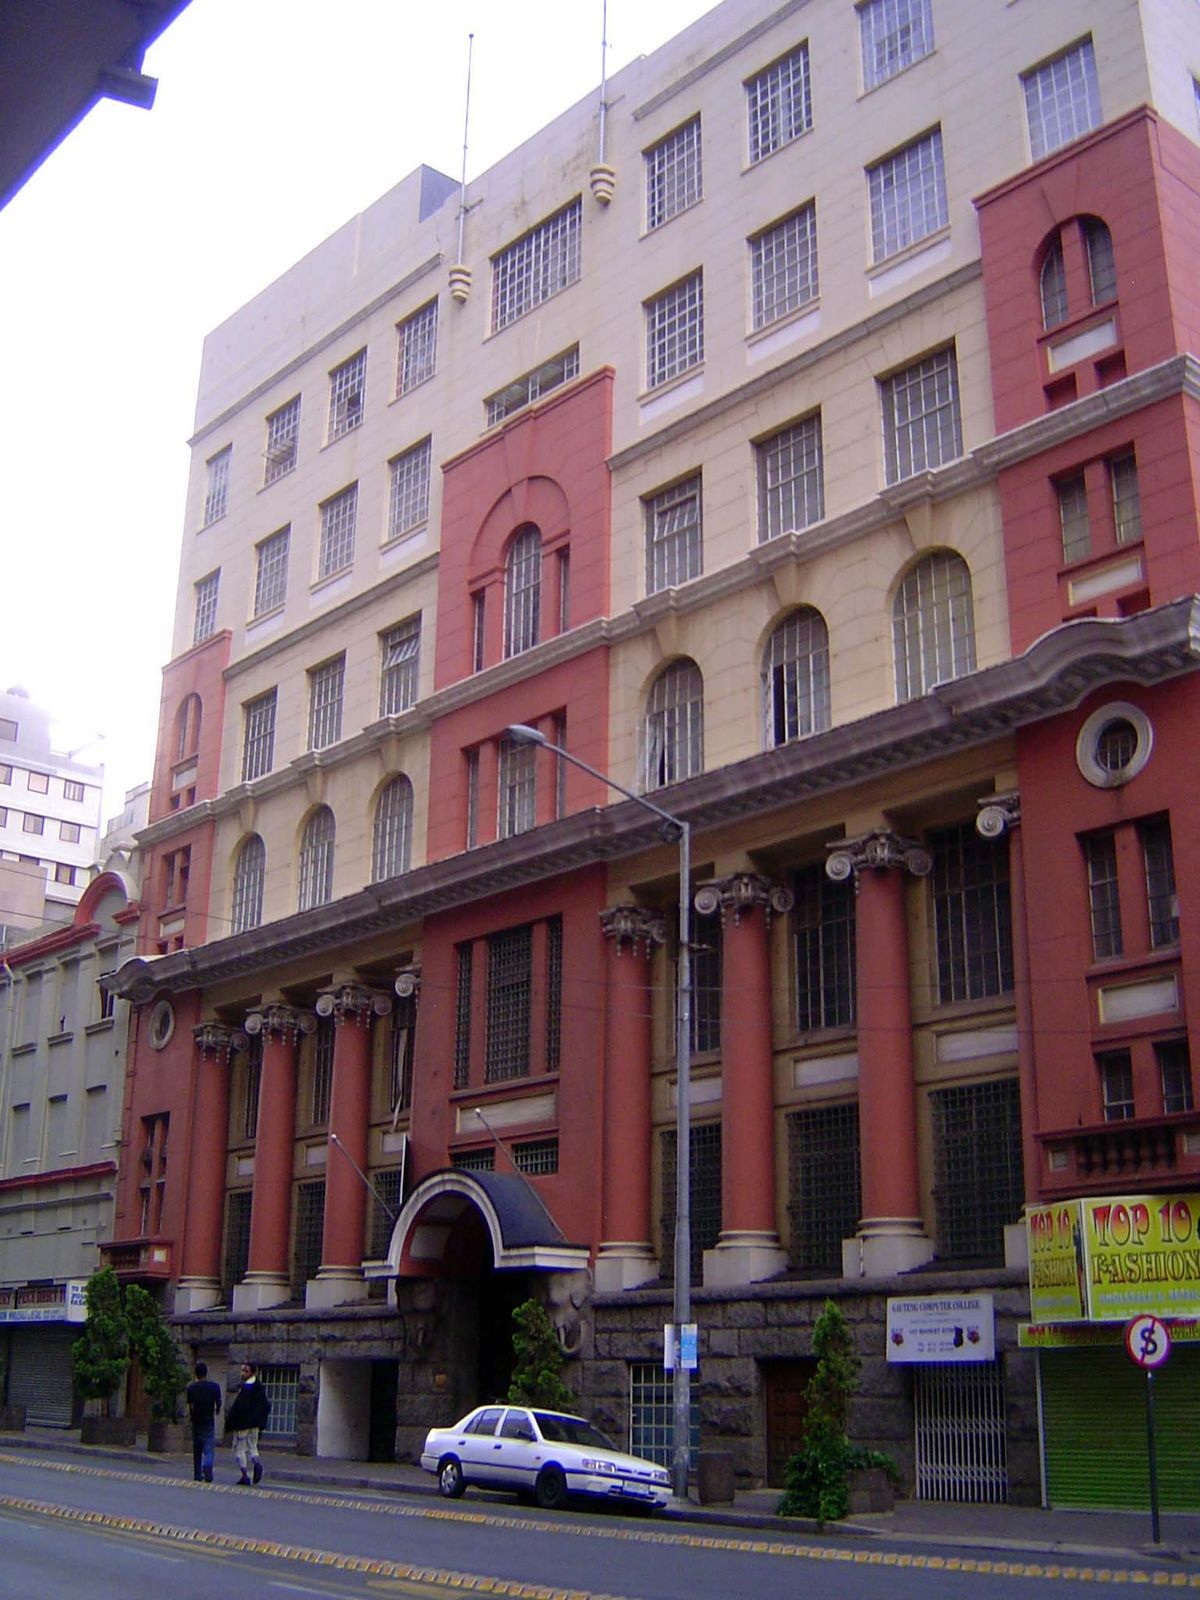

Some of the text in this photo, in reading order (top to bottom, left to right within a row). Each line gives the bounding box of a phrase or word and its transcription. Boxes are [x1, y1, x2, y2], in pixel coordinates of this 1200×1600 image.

[1030, 1208, 1071, 1252] TOP 10
[1091, 1199, 1193, 1247] TOP 10
[1031, 1256, 1076, 1288] FASHION
[1090, 1249, 1200, 1286] FASHION
[892, 1299, 979, 1313] GAUTENG COMPUTER COLLEGE
